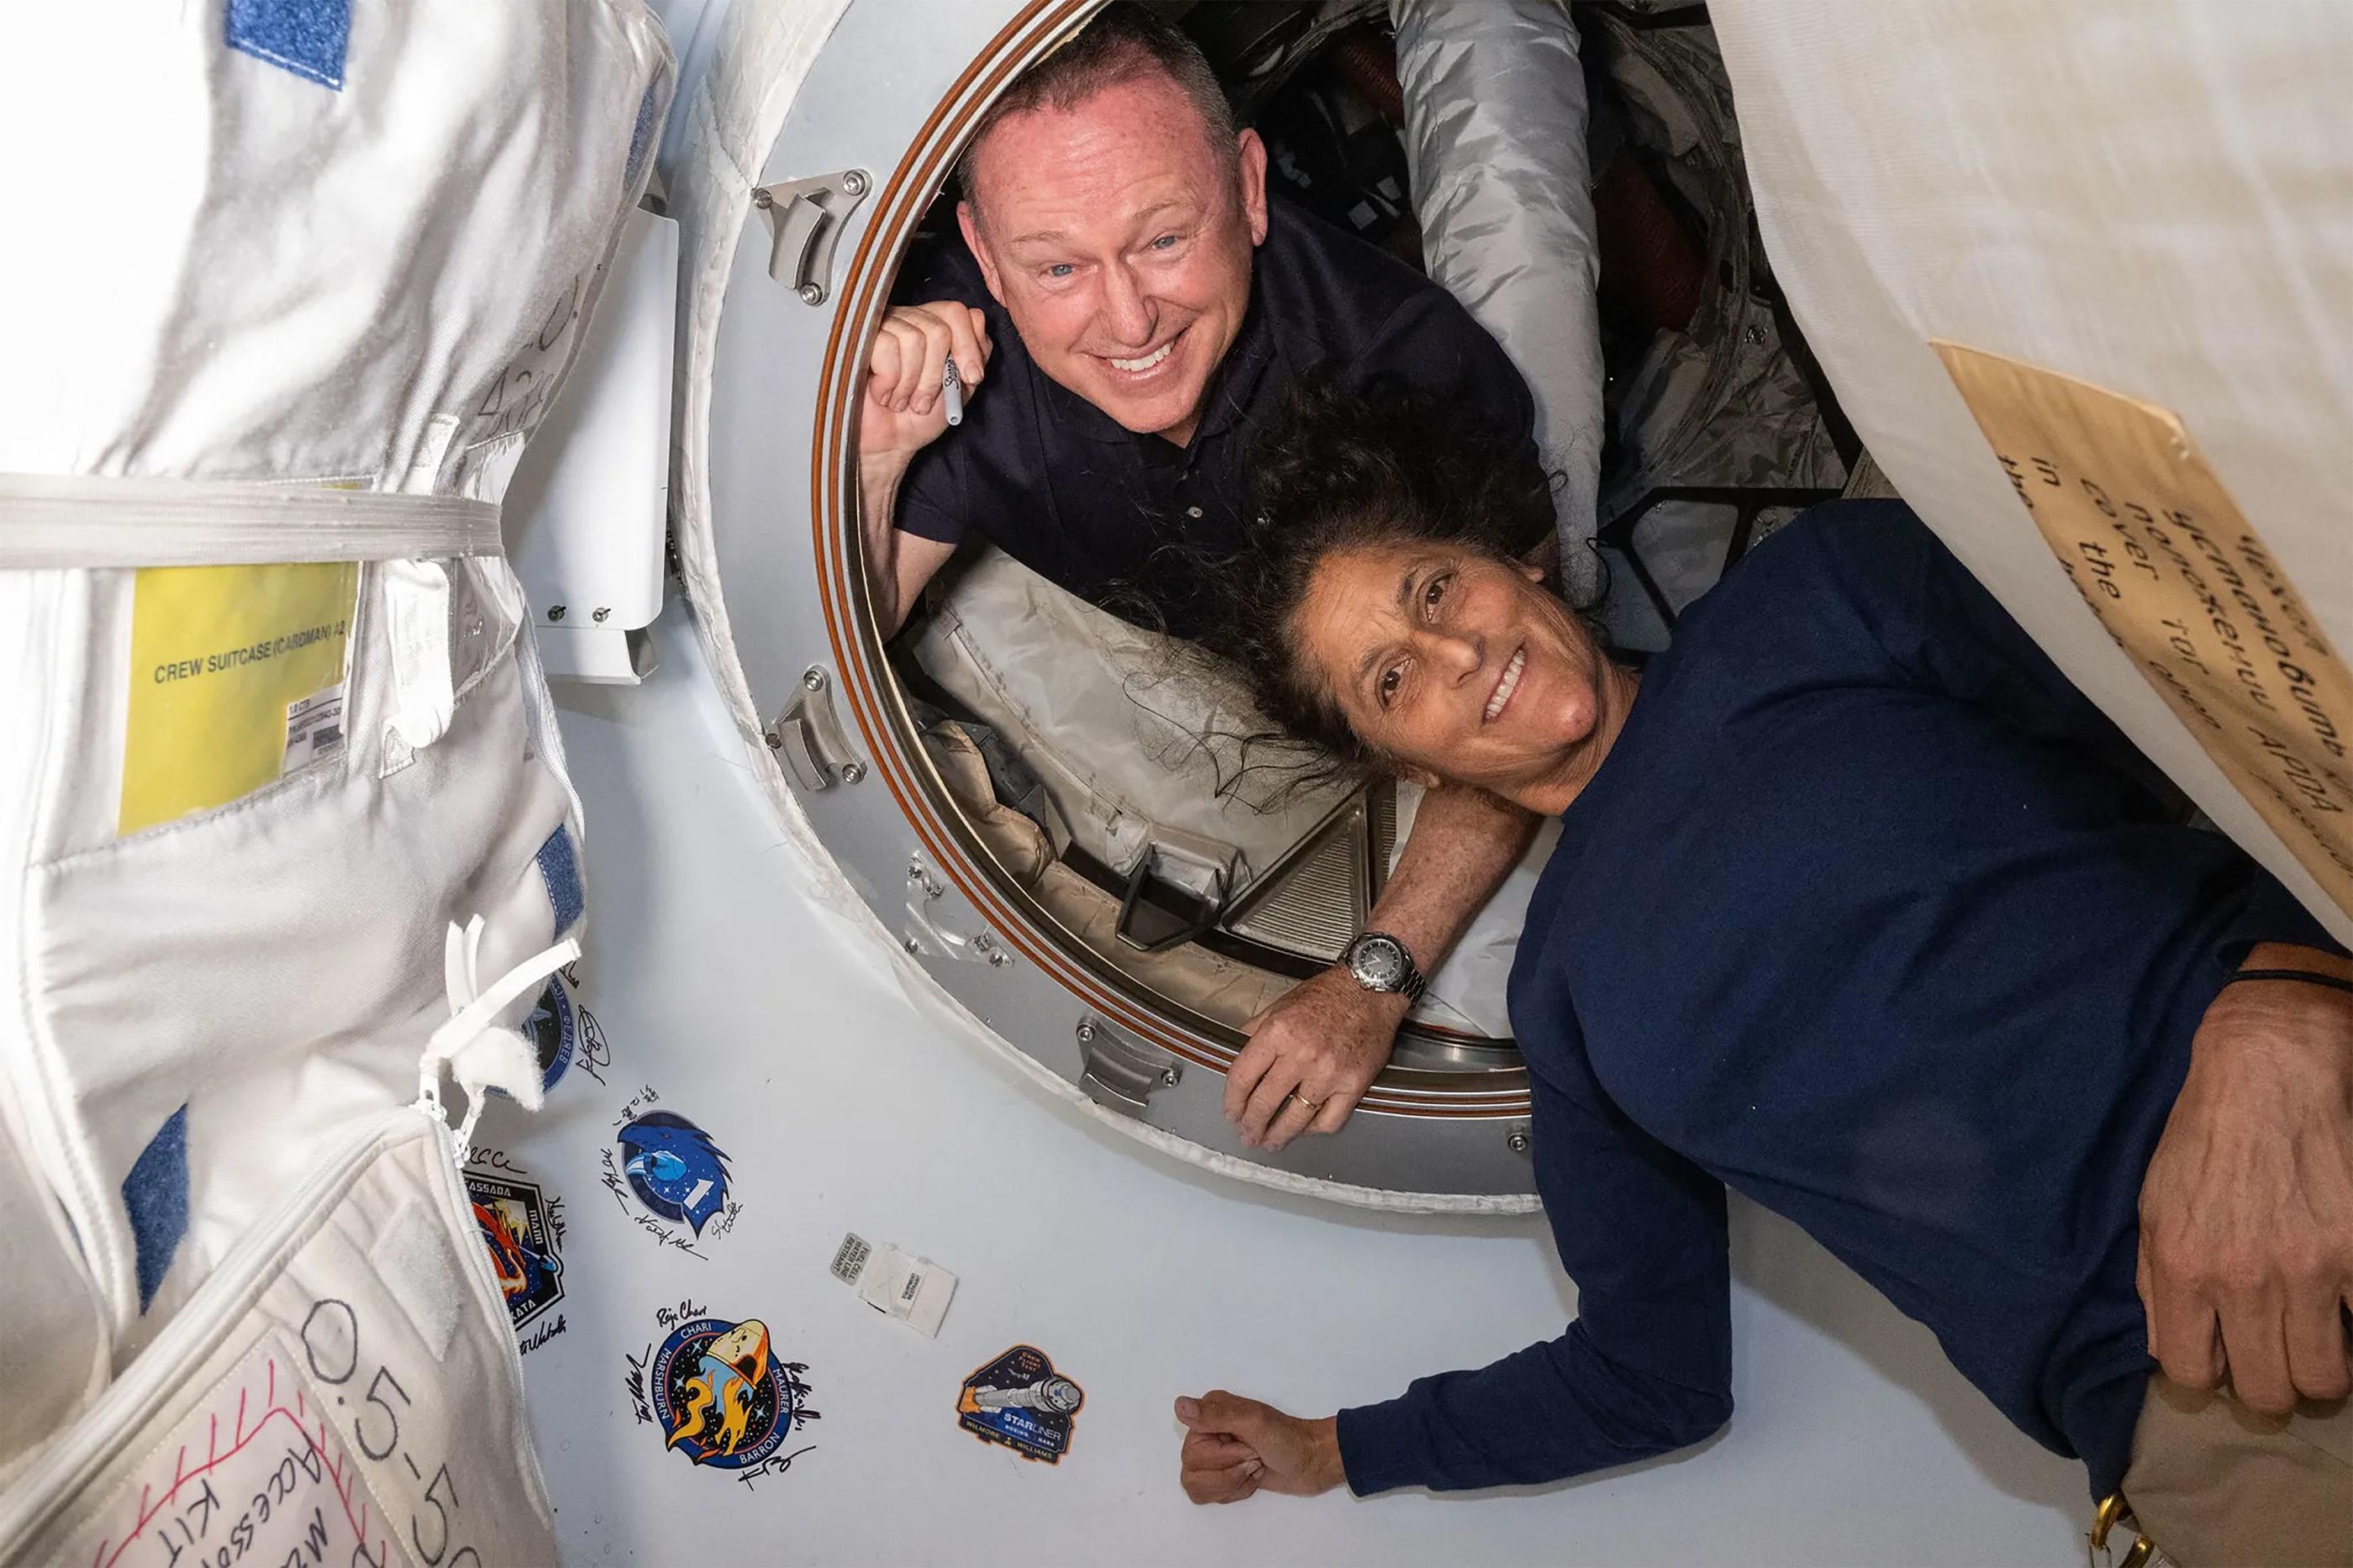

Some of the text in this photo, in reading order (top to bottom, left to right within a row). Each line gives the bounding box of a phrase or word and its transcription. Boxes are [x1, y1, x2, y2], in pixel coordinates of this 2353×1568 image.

[2031, 457, 2061, 487] in
[2079, 539, 2121, 600] the
[2081, 477, 2160, 582] cover
[154, 658, 203, 684] CREW
[208, 641, 271, 672] SUITCASE
[273, 625, 331, 658] (CARDMAN)
[560, 1015, 574, 1063] ФЕДЯЕВ
[466, 1180, 511, 1197] ASSADA
[529, 1209, 544, 1245] MANN
[834, 1237, 855, 1272] RESTRAINT
[848, 1240, 862, 1263] WATER
[848, 1246, 869, 1280] FUEL CELL
[680, 1323, 713, 1339] CHARI
[653, 1347, 672, 1419] MARSHBURN
[772, 1368, 790, 1413] MAURER
[301, 1298, 482, 1568] 0.5-5
[966, 1421, 1053, 1459] WILMORE WILLIAMS
[1003, 1413, 1061, 1441] STARLINER
[740, 1431, 780, 1464] BARRON
[157, 1479, 220, 1568] KIT
